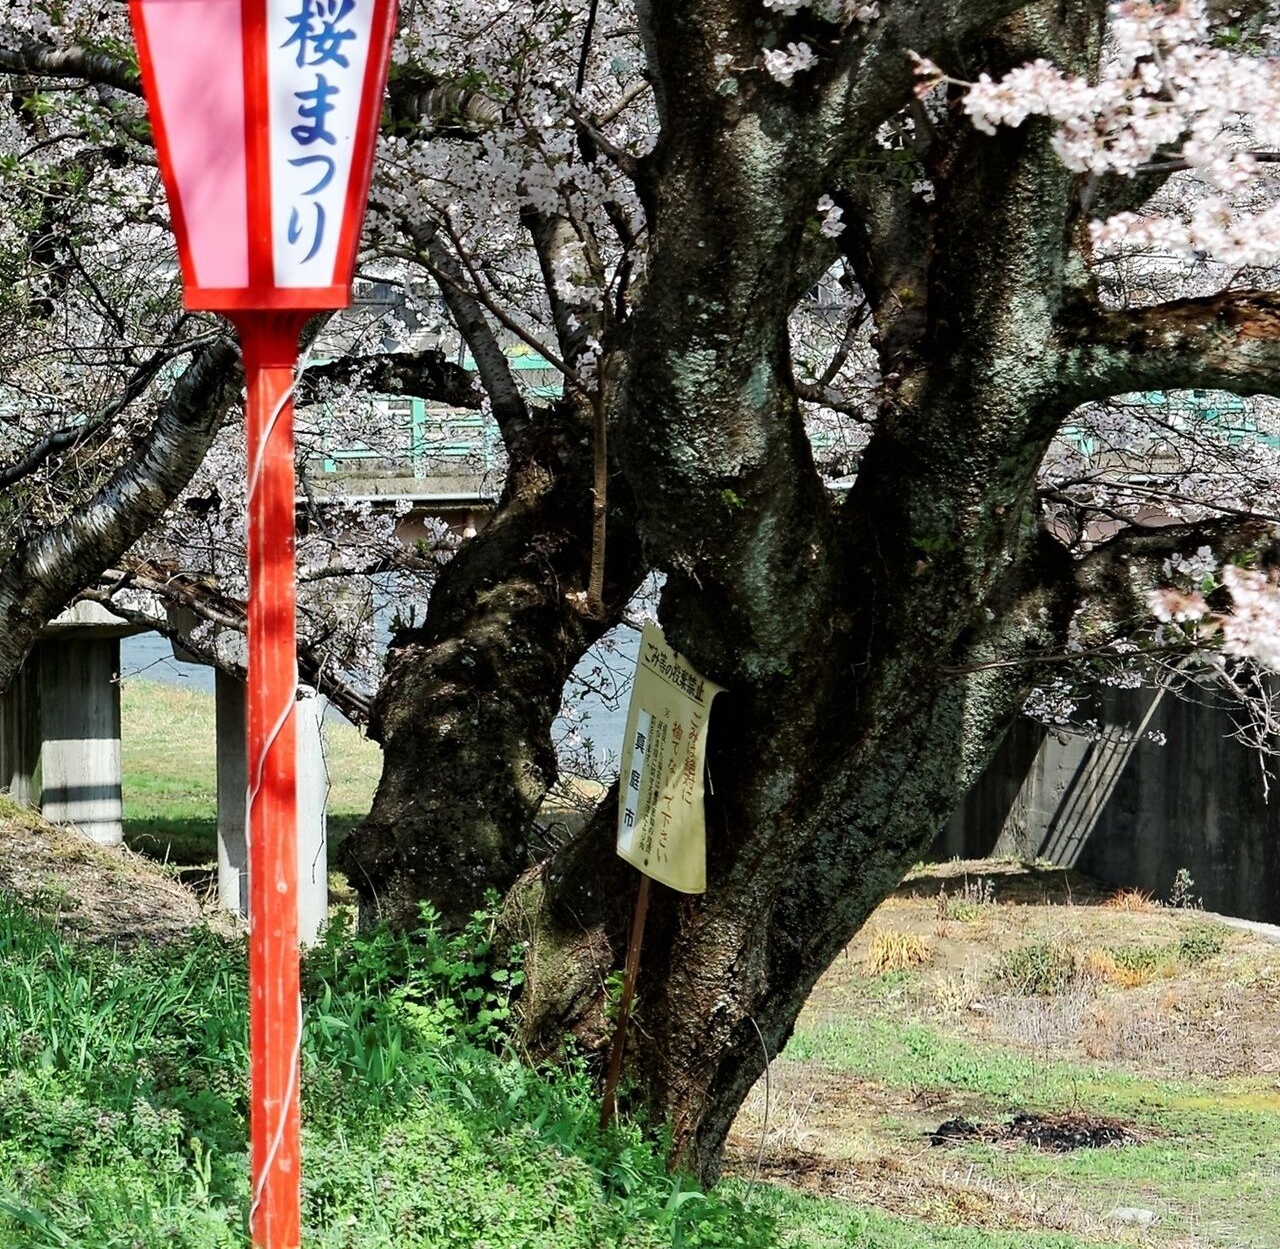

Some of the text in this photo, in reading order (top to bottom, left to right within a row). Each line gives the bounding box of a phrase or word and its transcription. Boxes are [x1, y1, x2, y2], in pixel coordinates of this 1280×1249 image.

[624, 732, 646, 829] 真庭市
[656, 720, 684, 863] 捨てないで下さい
